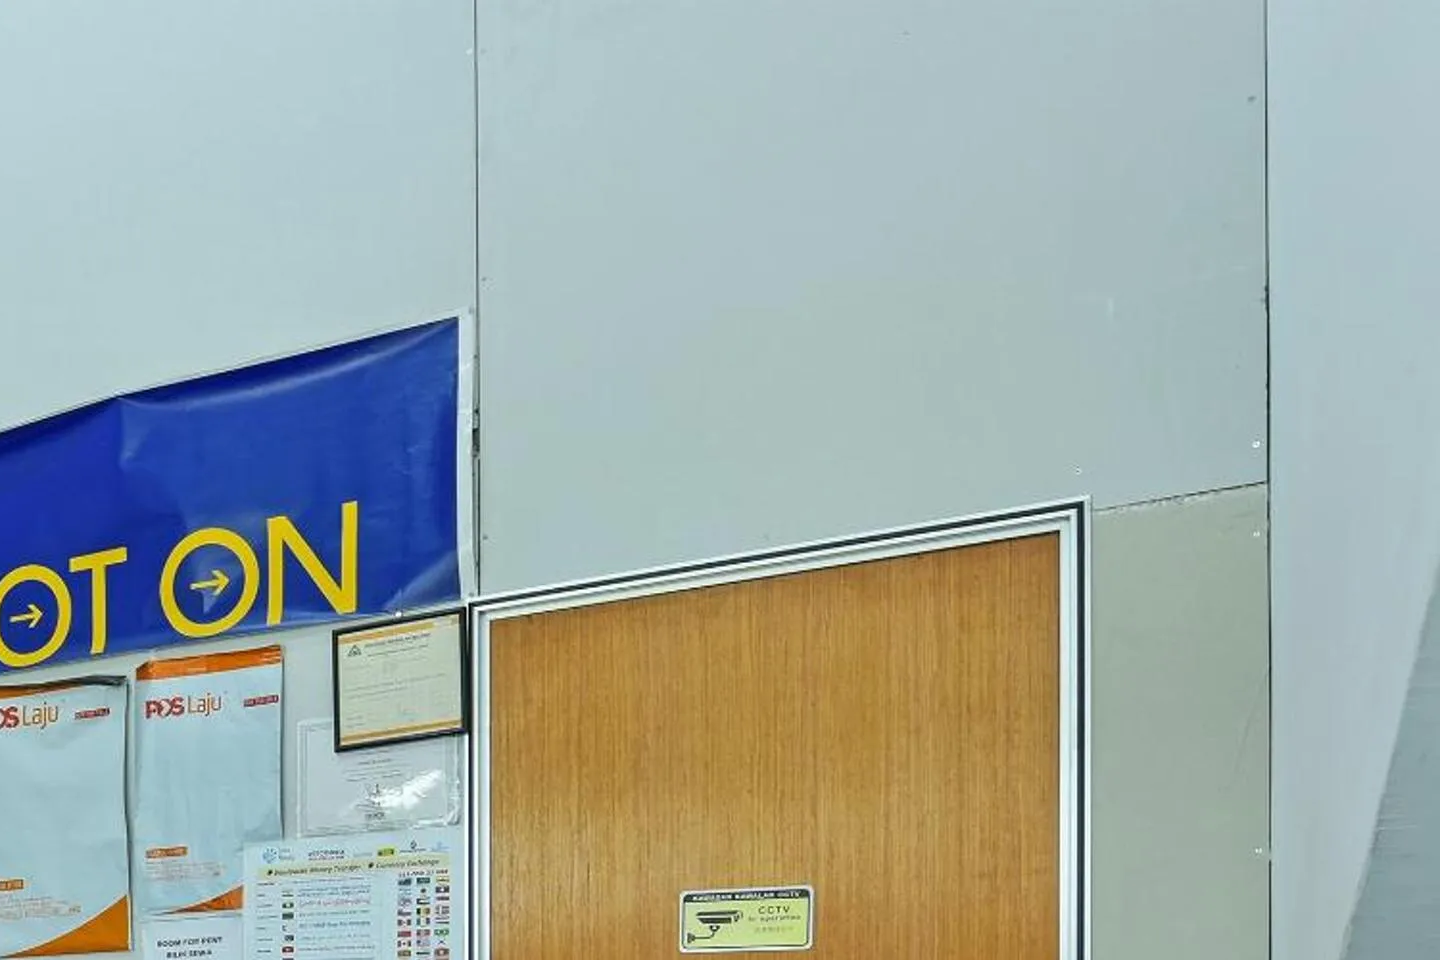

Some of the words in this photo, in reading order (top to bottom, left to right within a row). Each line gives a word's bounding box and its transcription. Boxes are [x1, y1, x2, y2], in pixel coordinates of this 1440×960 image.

[160, 500, 358, 639] ON
[22, 701, 59, 731] Laju
[145, 696, 185, 719] POS
[188, 692, 222, 716] Laju
[758, 905, 791, 915] CCTV
[157, 939, 181, 948] ROOM
[182, 938, 200, 946] FOR
[201, 936, 223, 944] RENT
